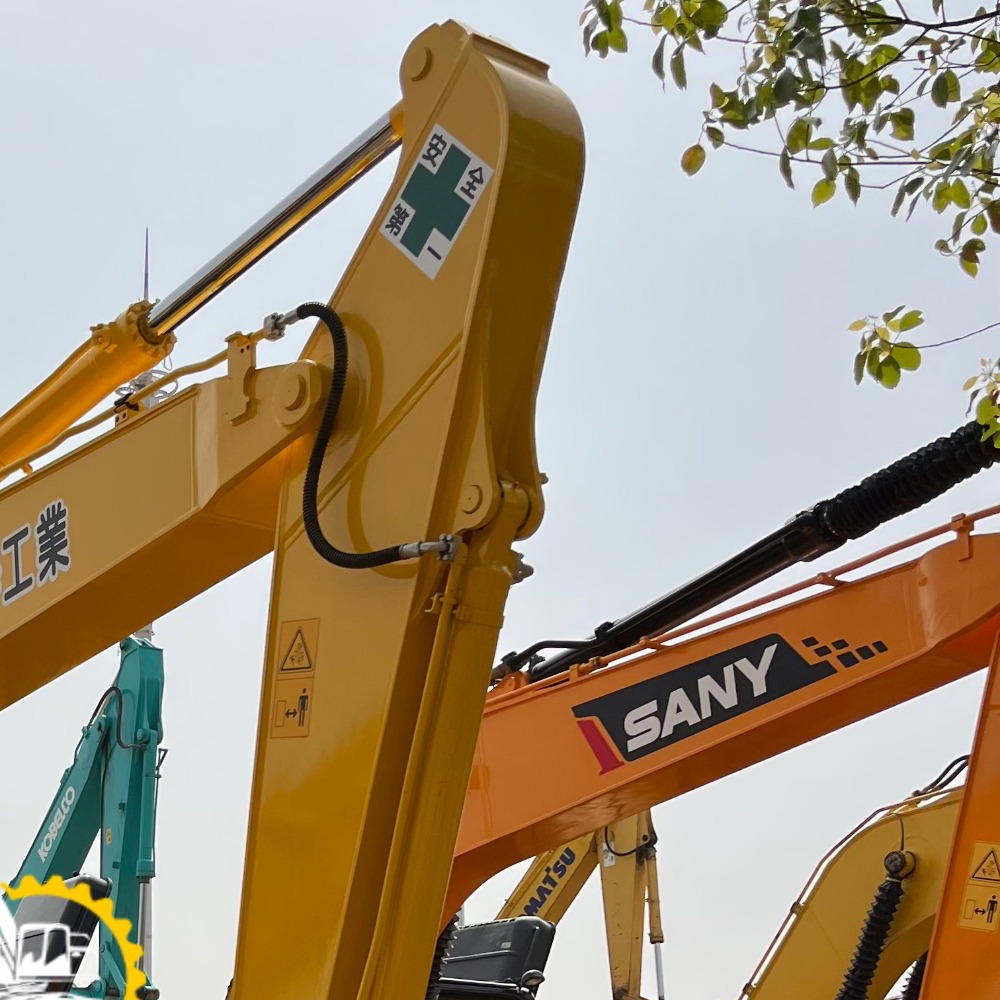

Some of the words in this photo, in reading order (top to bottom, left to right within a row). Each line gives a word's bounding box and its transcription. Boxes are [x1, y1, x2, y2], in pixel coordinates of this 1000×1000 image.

[623, 643, 778, 753] SANY
[37, 786, 76, 863] KOBELCO
[520, 847, 576, 916] MATSU
